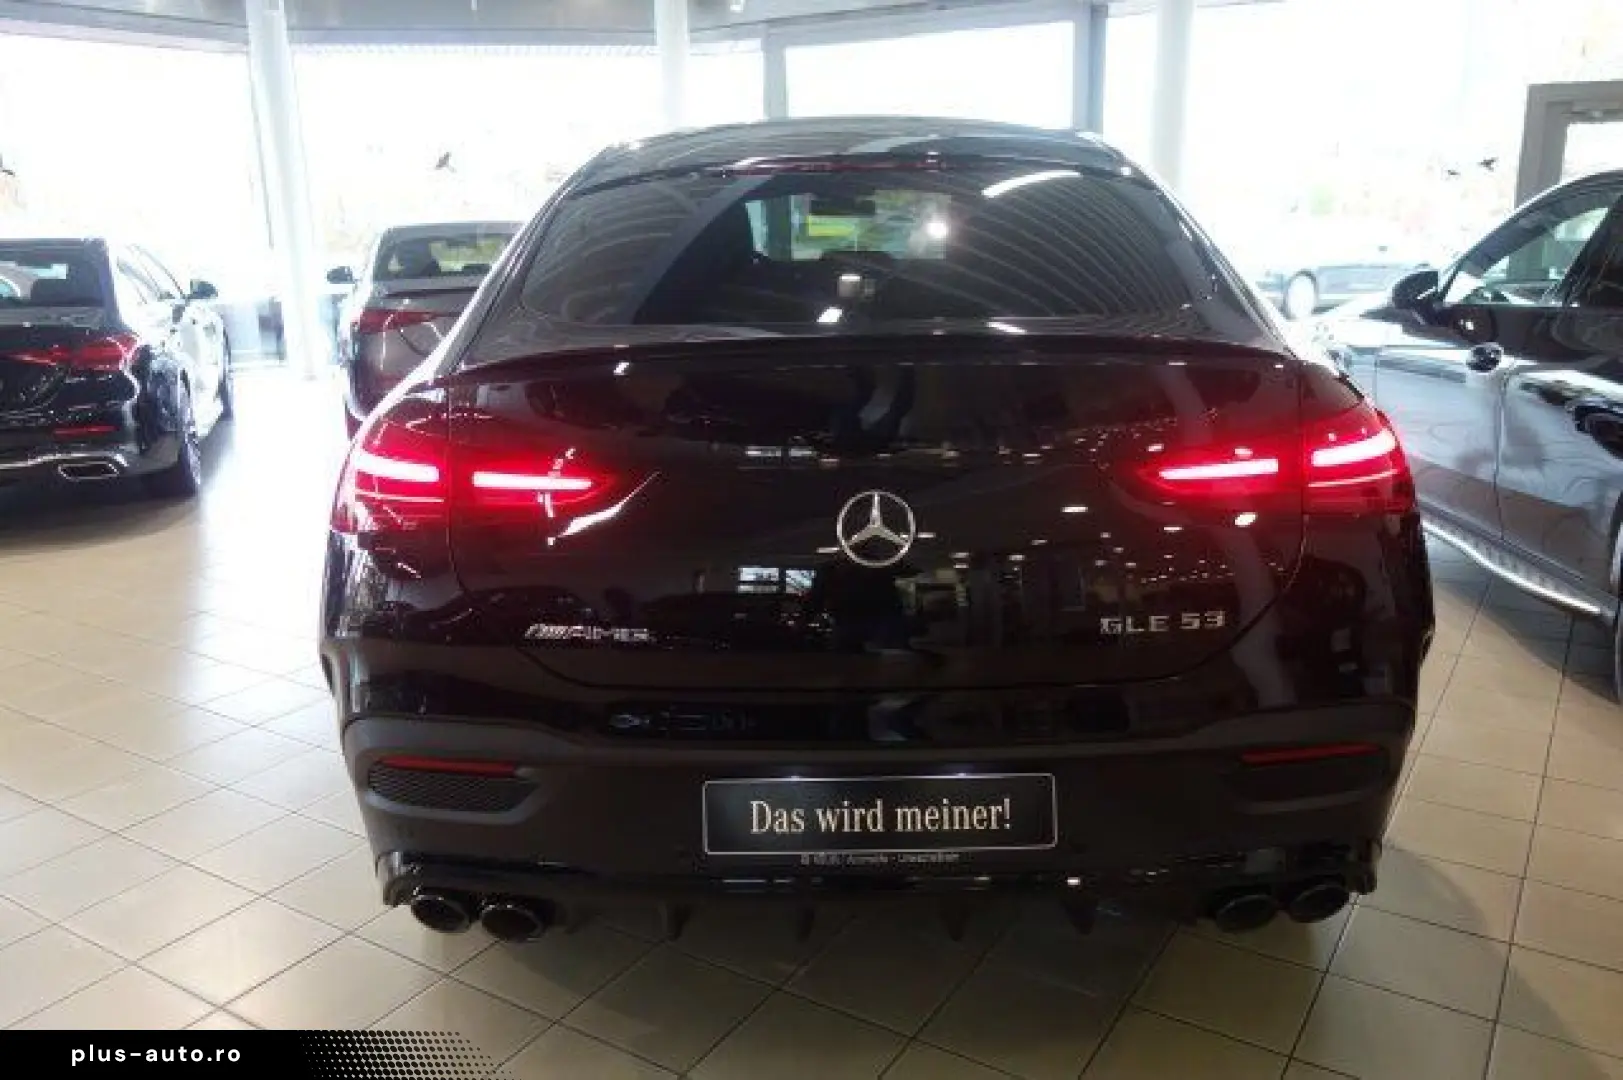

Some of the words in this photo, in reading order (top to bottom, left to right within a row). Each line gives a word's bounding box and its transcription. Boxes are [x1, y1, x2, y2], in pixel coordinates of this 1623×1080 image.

[1100, 615, 1170, 634] GLE
[1180, 611, 1226, 630] 53
[750, 800, 805, 834] Das
[814, 800, 885, 832] wird
[895, 798, 1010, 832] meiner!
